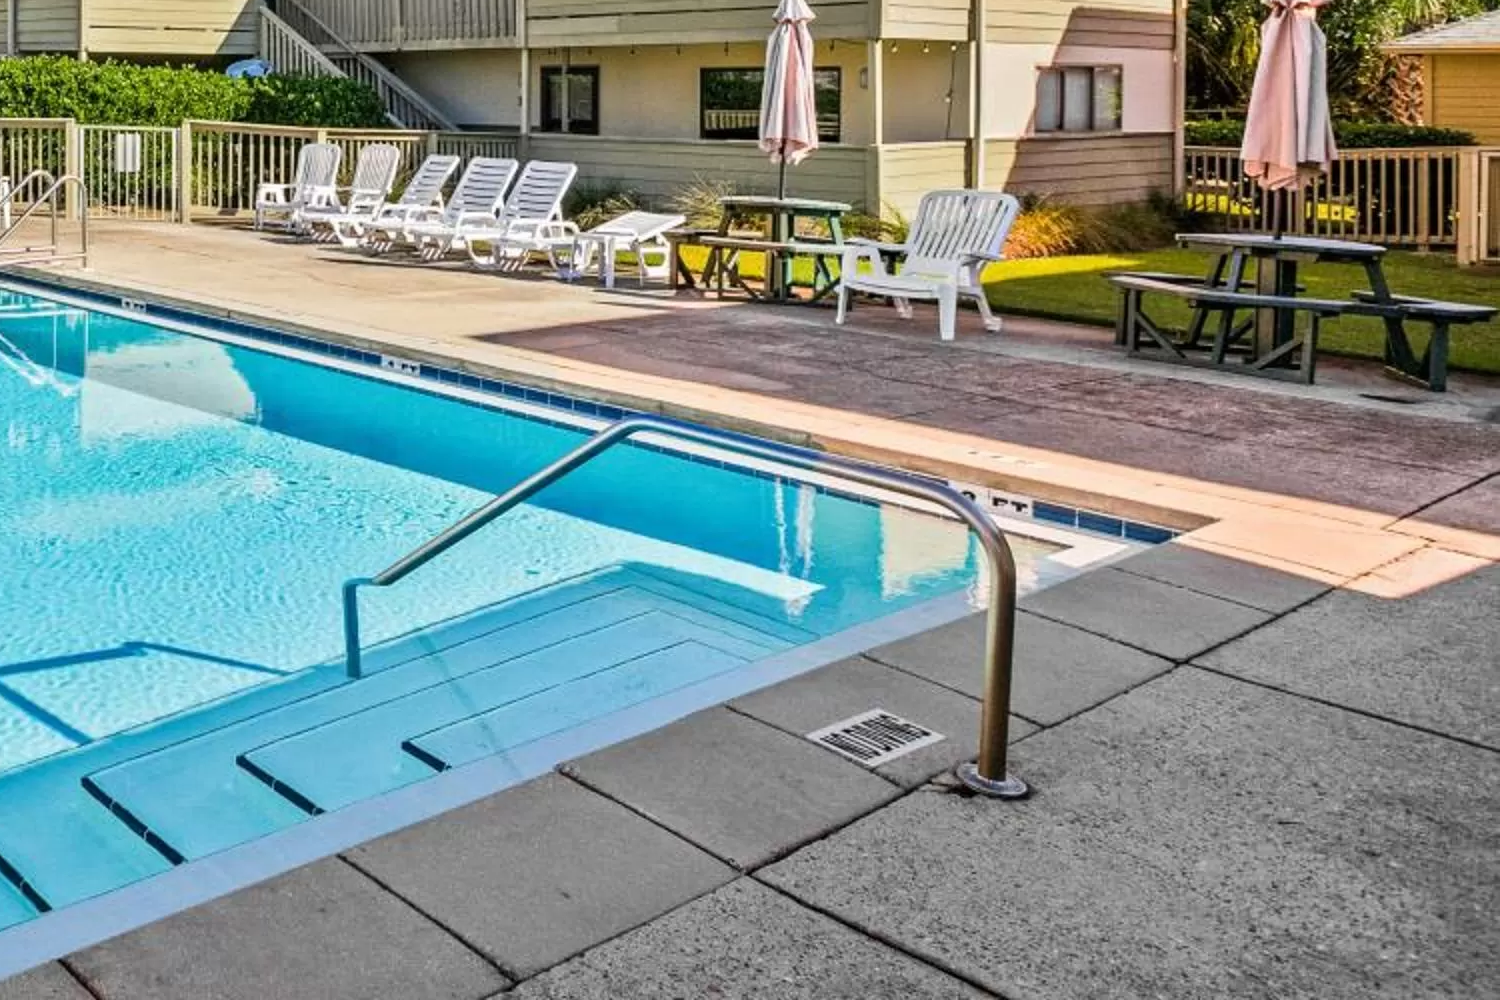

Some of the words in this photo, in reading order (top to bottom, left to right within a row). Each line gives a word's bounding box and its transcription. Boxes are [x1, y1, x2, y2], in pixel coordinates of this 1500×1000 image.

[992, 496, 1029, 513] FT
[818, 732, 884, 760] NO
[839, 713, 933, 751] DIVING
